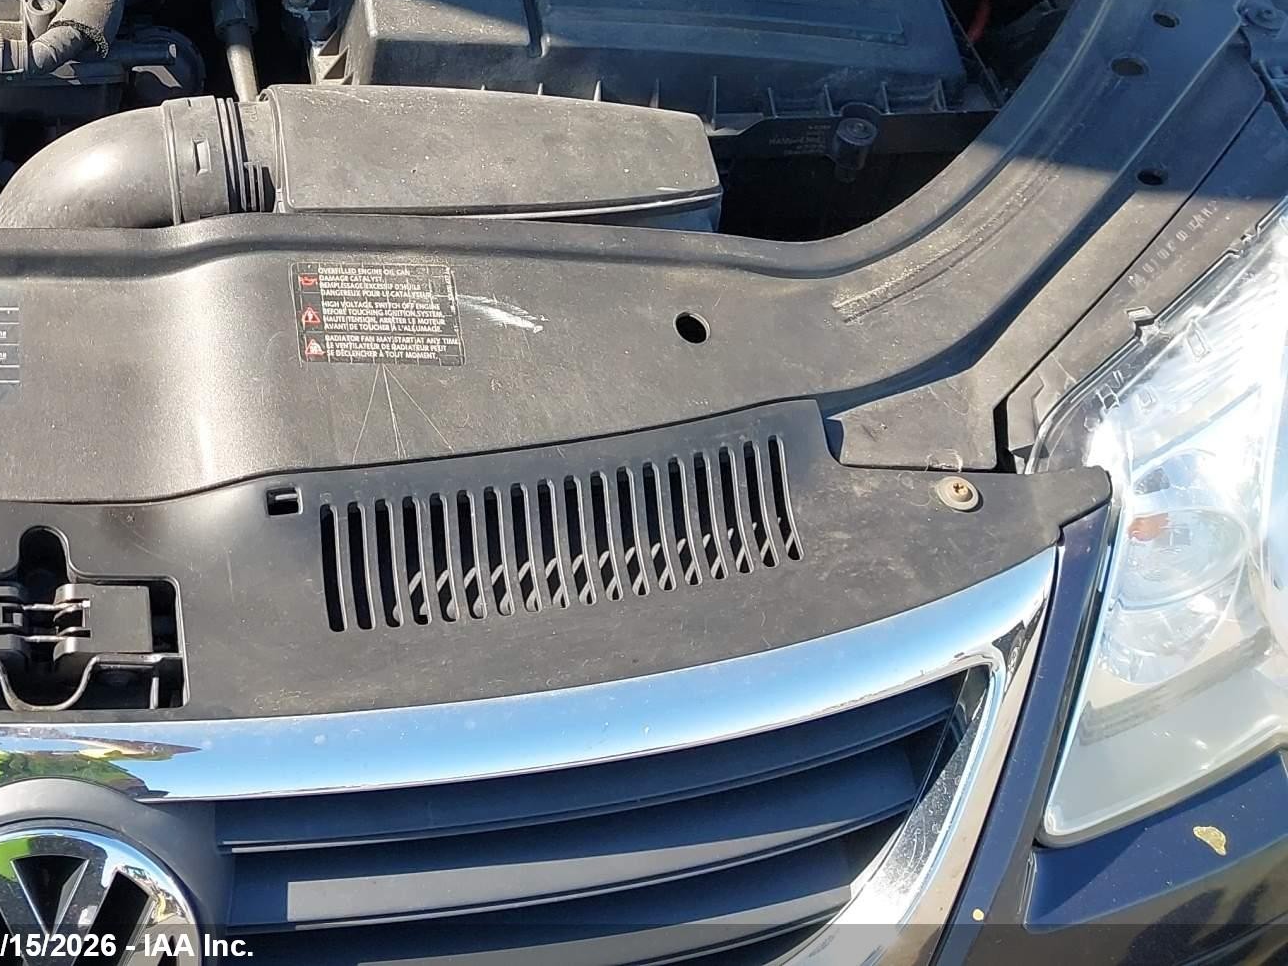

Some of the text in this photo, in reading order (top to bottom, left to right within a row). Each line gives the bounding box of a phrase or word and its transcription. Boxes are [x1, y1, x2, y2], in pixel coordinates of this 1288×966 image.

[383, 268, 395, 276] OIL
[321, 289, 361, 297] DANGEREUX
[362, 290, 380, 298] POUR
[375, 302, 400, 310] SWITCH
[402, 302, 415, 310] OFF
[416, 303, 441, 311] ENGINE
[348, 308, 383, 316] TOUCHING
[385, 309, 415, 317] IGNITION
[323, 315, 346, 323] HAUTE
[408, 317, 416, 325] LE
[417, 318, 446, 326] MOTEUR
[349, 323, 358, 331] DE
[359, 323, 390, 331] TOUCHER
[325, 334, 360, 342] RADIATOR
[376, 335, 392, 343] MAY
[394, 336, 414, 344] START
[416, 336, 424, 344] AT
[426, 337, 440, 345] ANY
[326, 341, 447, 352] LE VENTILATEUR DE RADIATEUR PEUT
[385, 350, 404, 358] TOUT
